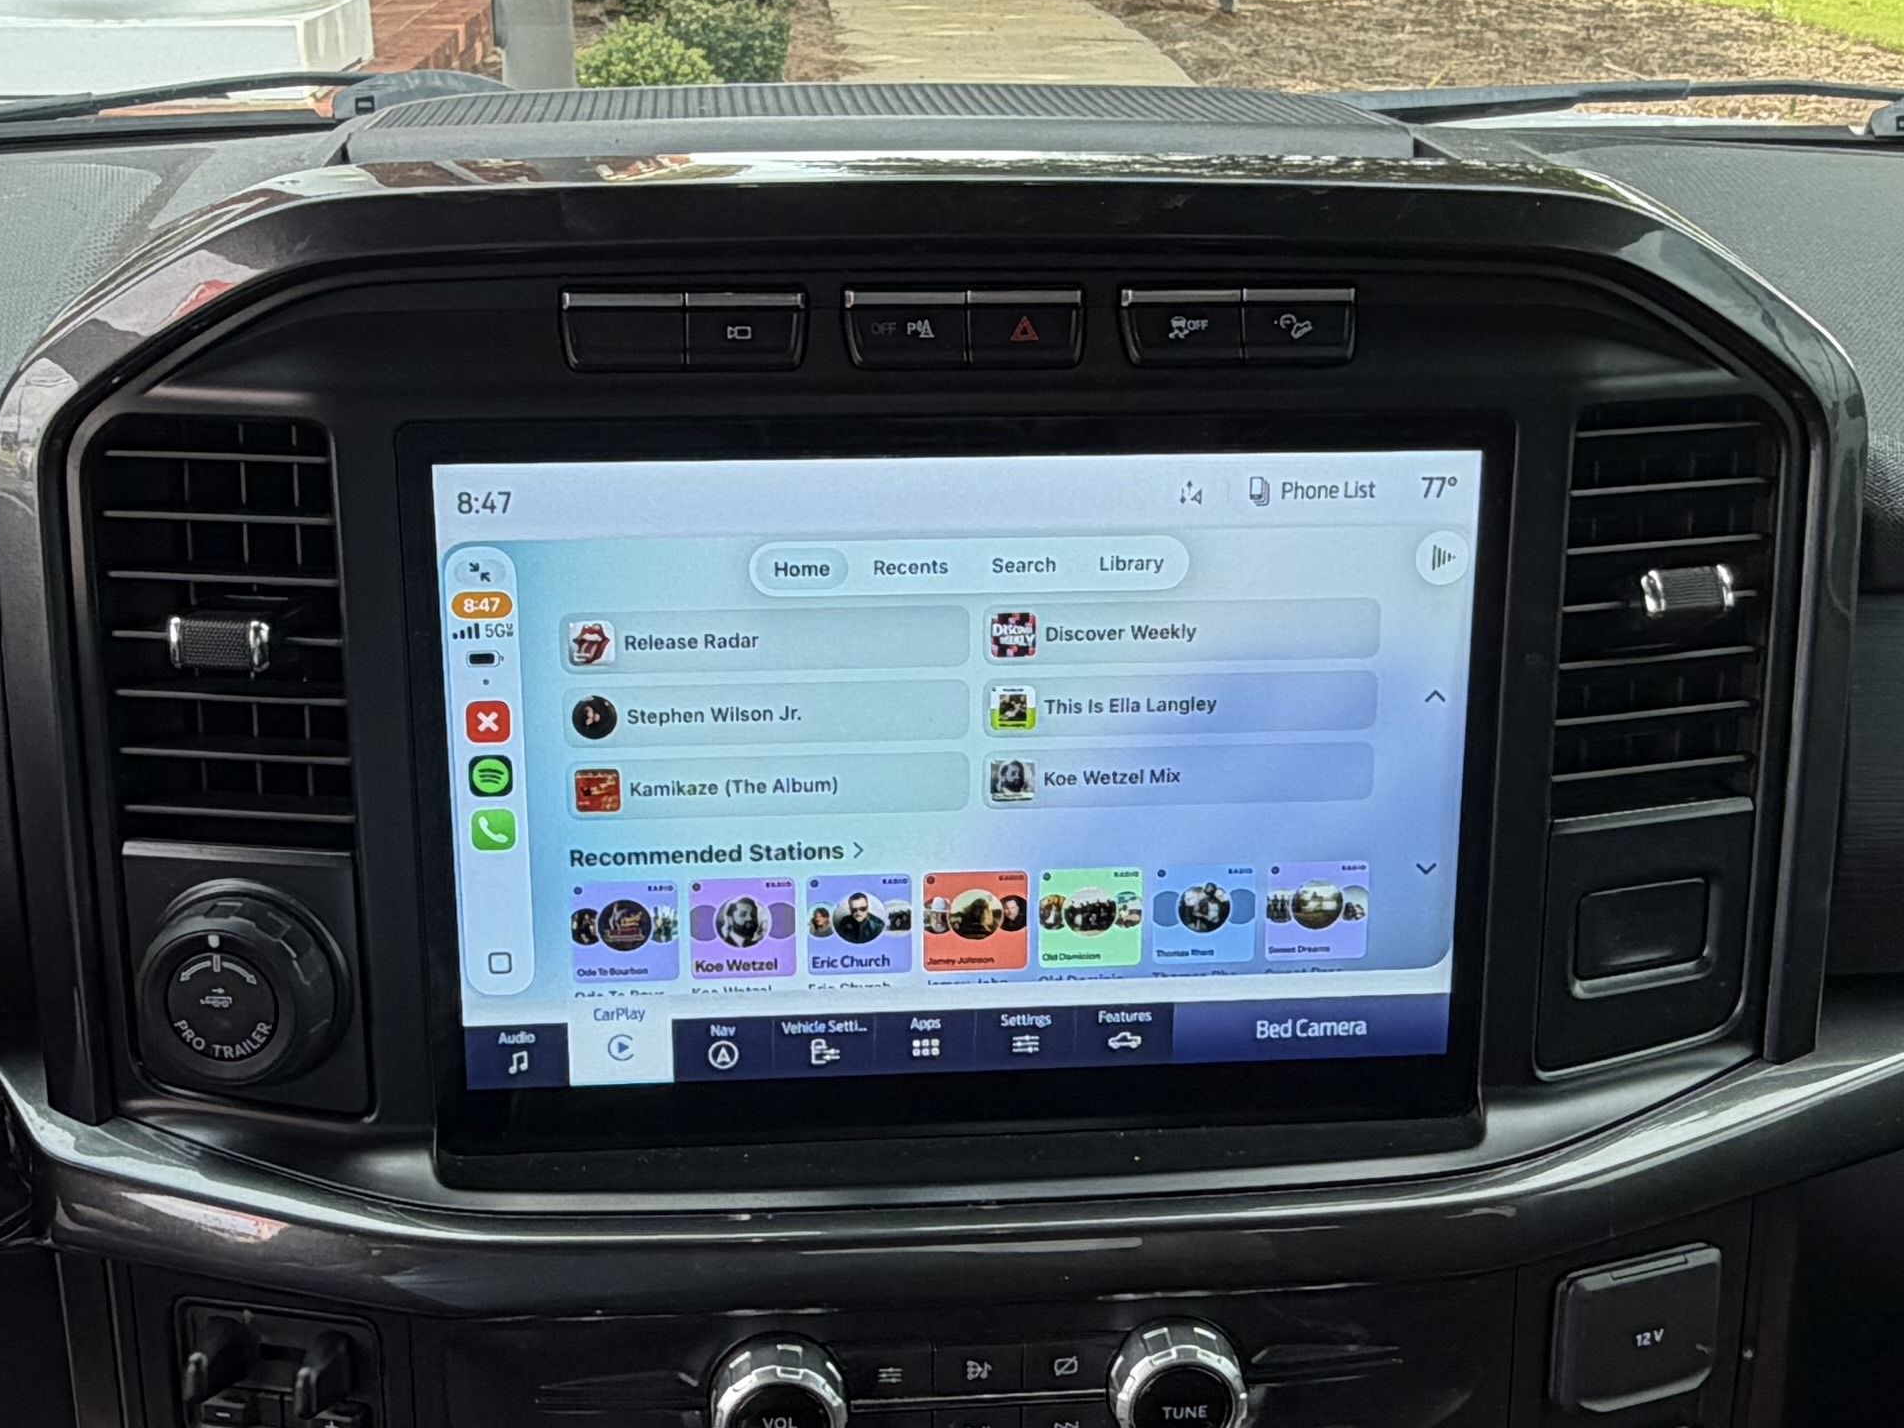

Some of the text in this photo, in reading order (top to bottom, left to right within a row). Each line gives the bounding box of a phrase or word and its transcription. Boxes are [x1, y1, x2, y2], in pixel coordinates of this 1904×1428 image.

[1187, 319, 1209, 332] OFF
[1280, 479, 1377, 502] Phone List
[1421, 475, 1458, 499] 77°
[456, 490, 512, 515] 8:47
[773, 559, 831, 578] Home
[872, 557, 949, 577] Recents
[991, 556, 1057, 575] Search
[1098, 554, 1165, 576] Library
[463, 597, 501, 613] 8:47
[623, 631, 760, 652] Release Radar
[1045, 623, 1197, 644] Discover Weekly
[626, 704, 803, 728] Stephen Wilson Jr.
[1043, 695, 1218, 717] This Is Ella Langley
[628, 775, 839, 800] Kamikaze (The Album)
[1043, 767, 1181, 788] Koe Wetzel Mix
[569, 842, 845, 868] Recommended Stations
[694, 957, 778, 974] Koe Wetzel
[811, 954, 891, 970] Eric Church
[592, 1006, 647, 1023] CarPlay
[909, 1016, 942, 1033] Apps
[999, 1012, 1052, 1029] Settings
[1097, 1009, 1153, 1025] Features
[710, 1022, 737, 1038] Nav
[781, 1018, 826, 1035] Vehicle
[1255, 1017, 1369, 1041] Bed Camera
[173, 1018, 273, 1059] PRO TRAILER
[498, 1030, 537, 1046] Audio
[1635, 1327, 1665, 1348] 12 V
[1161, 1404, 1209, 1421] TUNE
